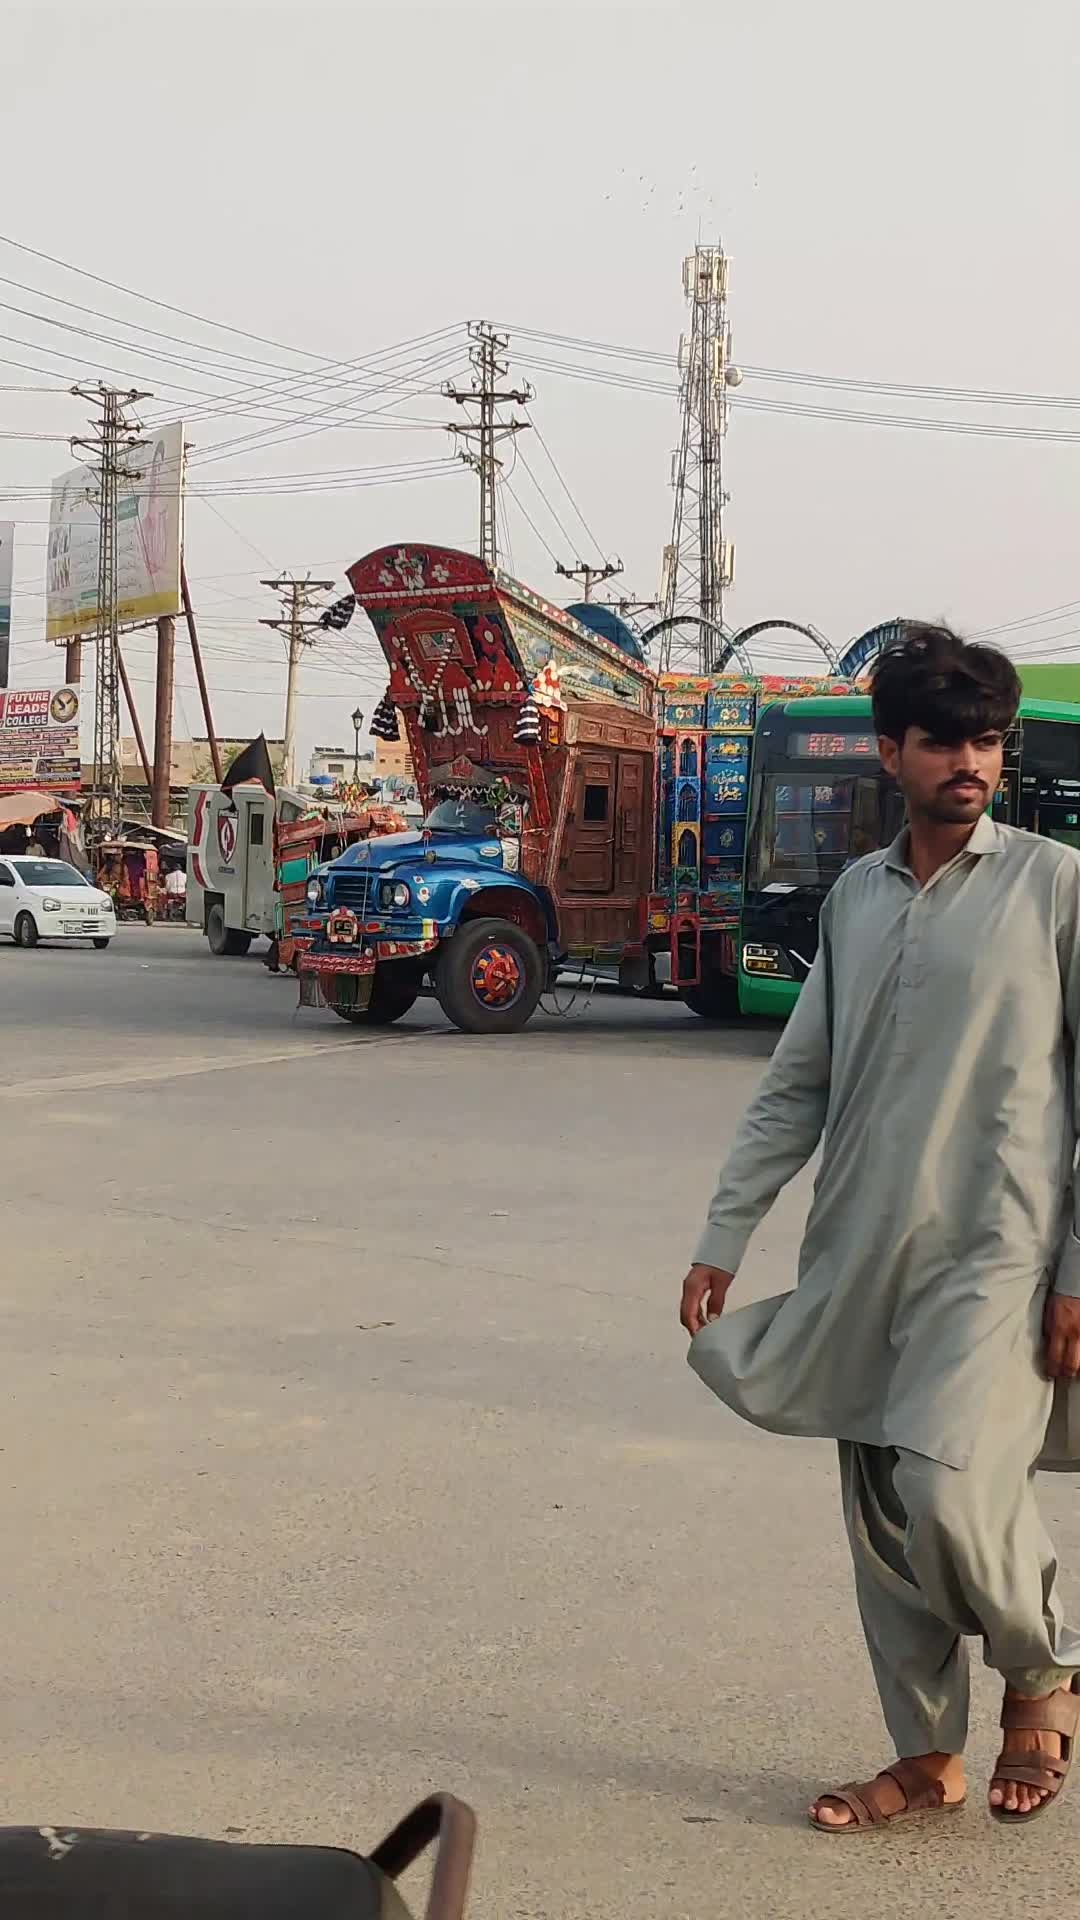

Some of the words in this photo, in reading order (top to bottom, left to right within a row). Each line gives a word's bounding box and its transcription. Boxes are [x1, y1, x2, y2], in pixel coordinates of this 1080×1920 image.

[9, 691, 49, 703] FUTURE
[7, 702, 48, 714] LEADS
[6, 715, 47, 726] COLLEGE
